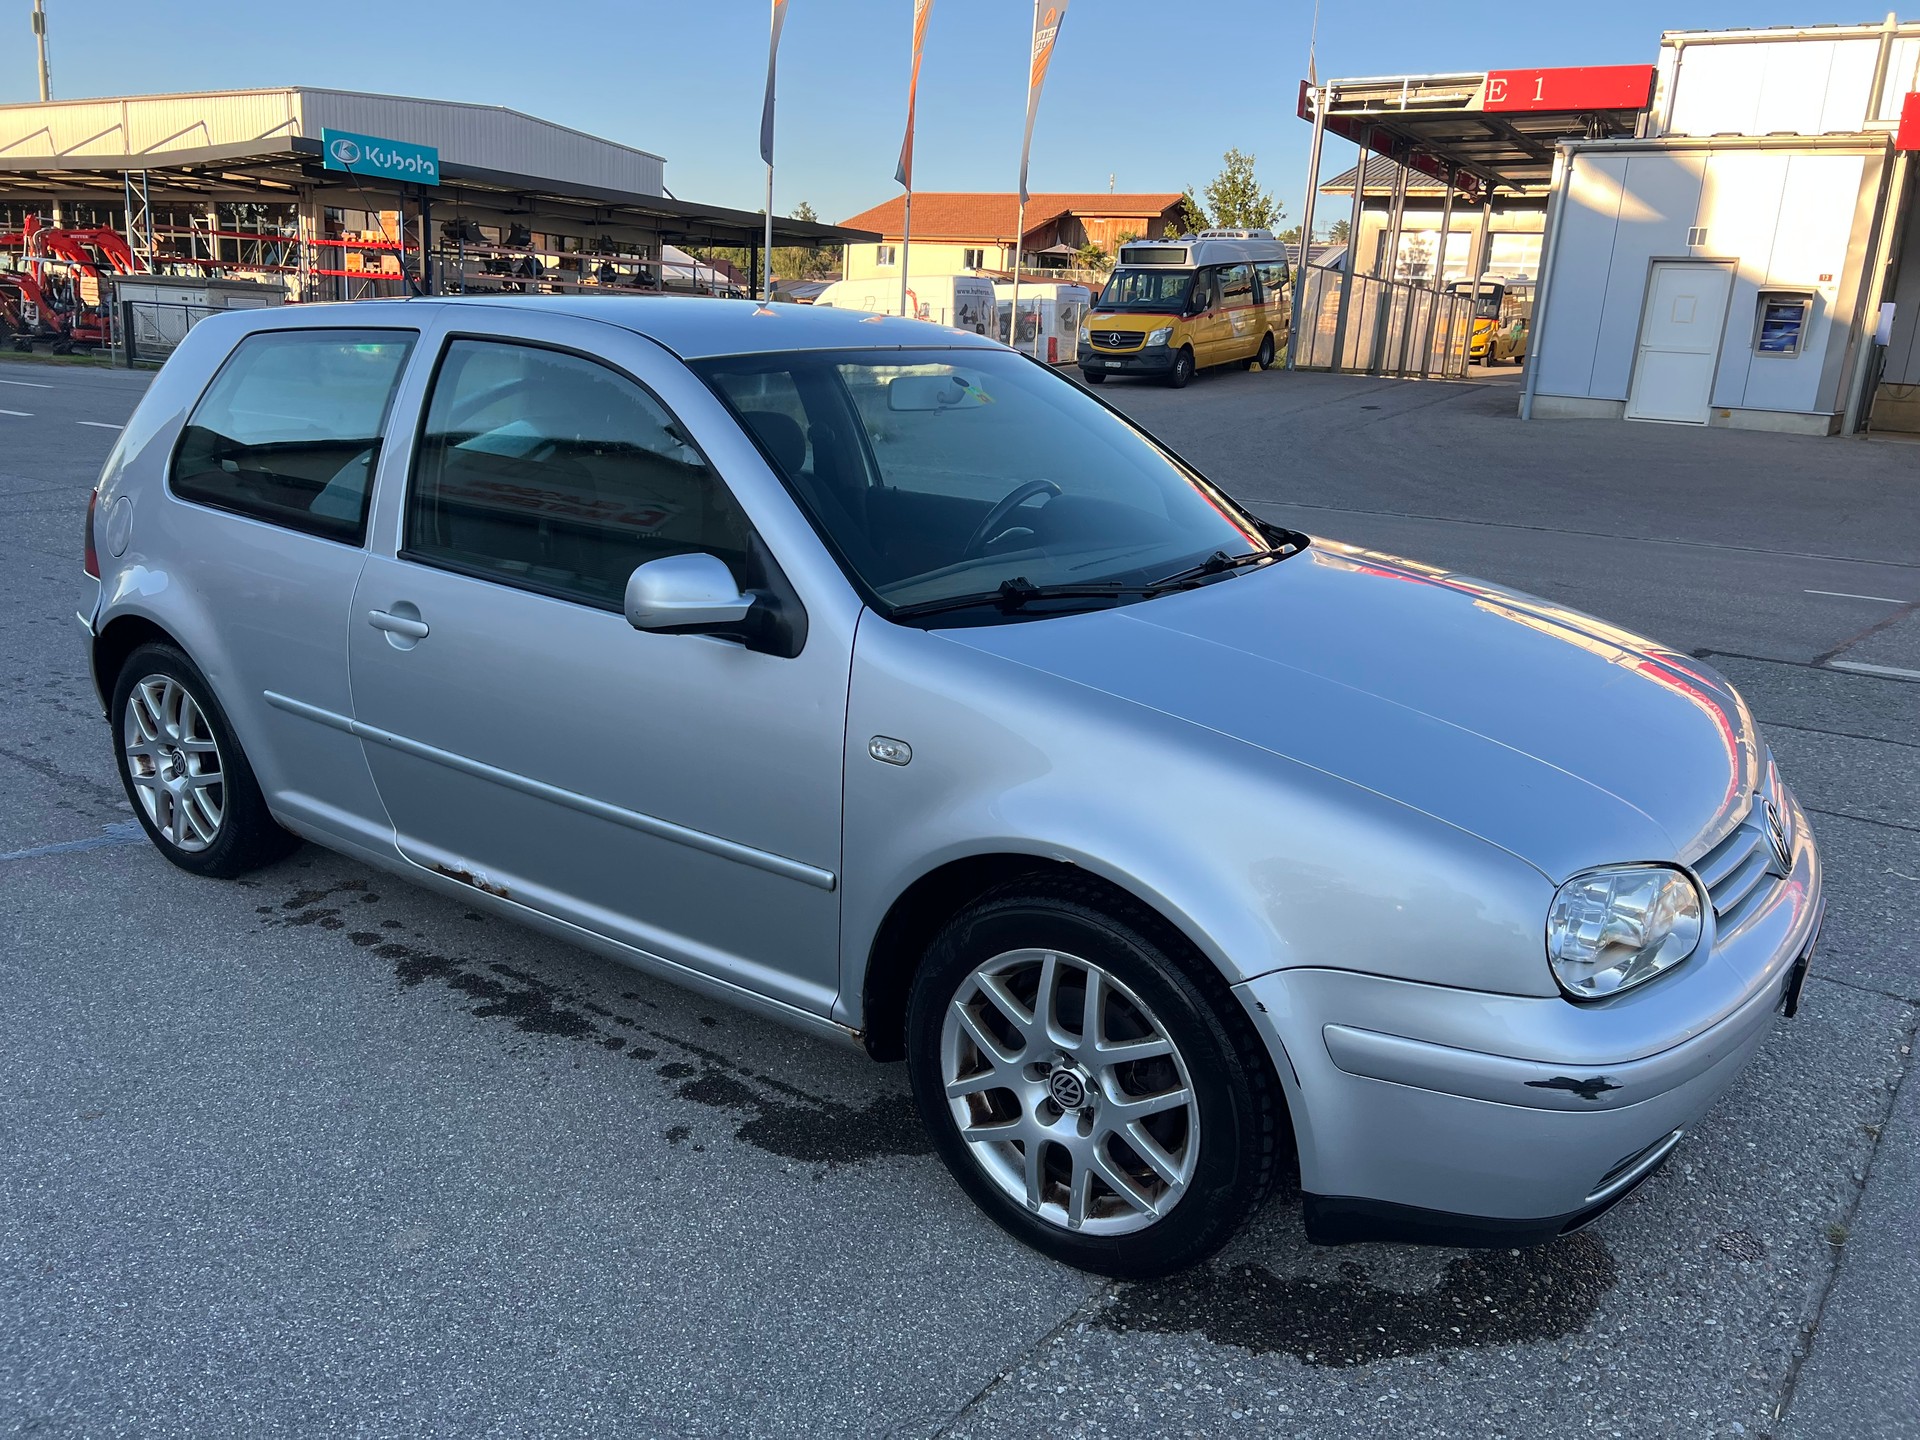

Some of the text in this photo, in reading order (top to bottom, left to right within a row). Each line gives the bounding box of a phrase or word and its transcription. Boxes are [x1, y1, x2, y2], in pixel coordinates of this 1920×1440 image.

[1486, 77, 1544, 103] E 1
[365, 145, 434, 176] Kubota
